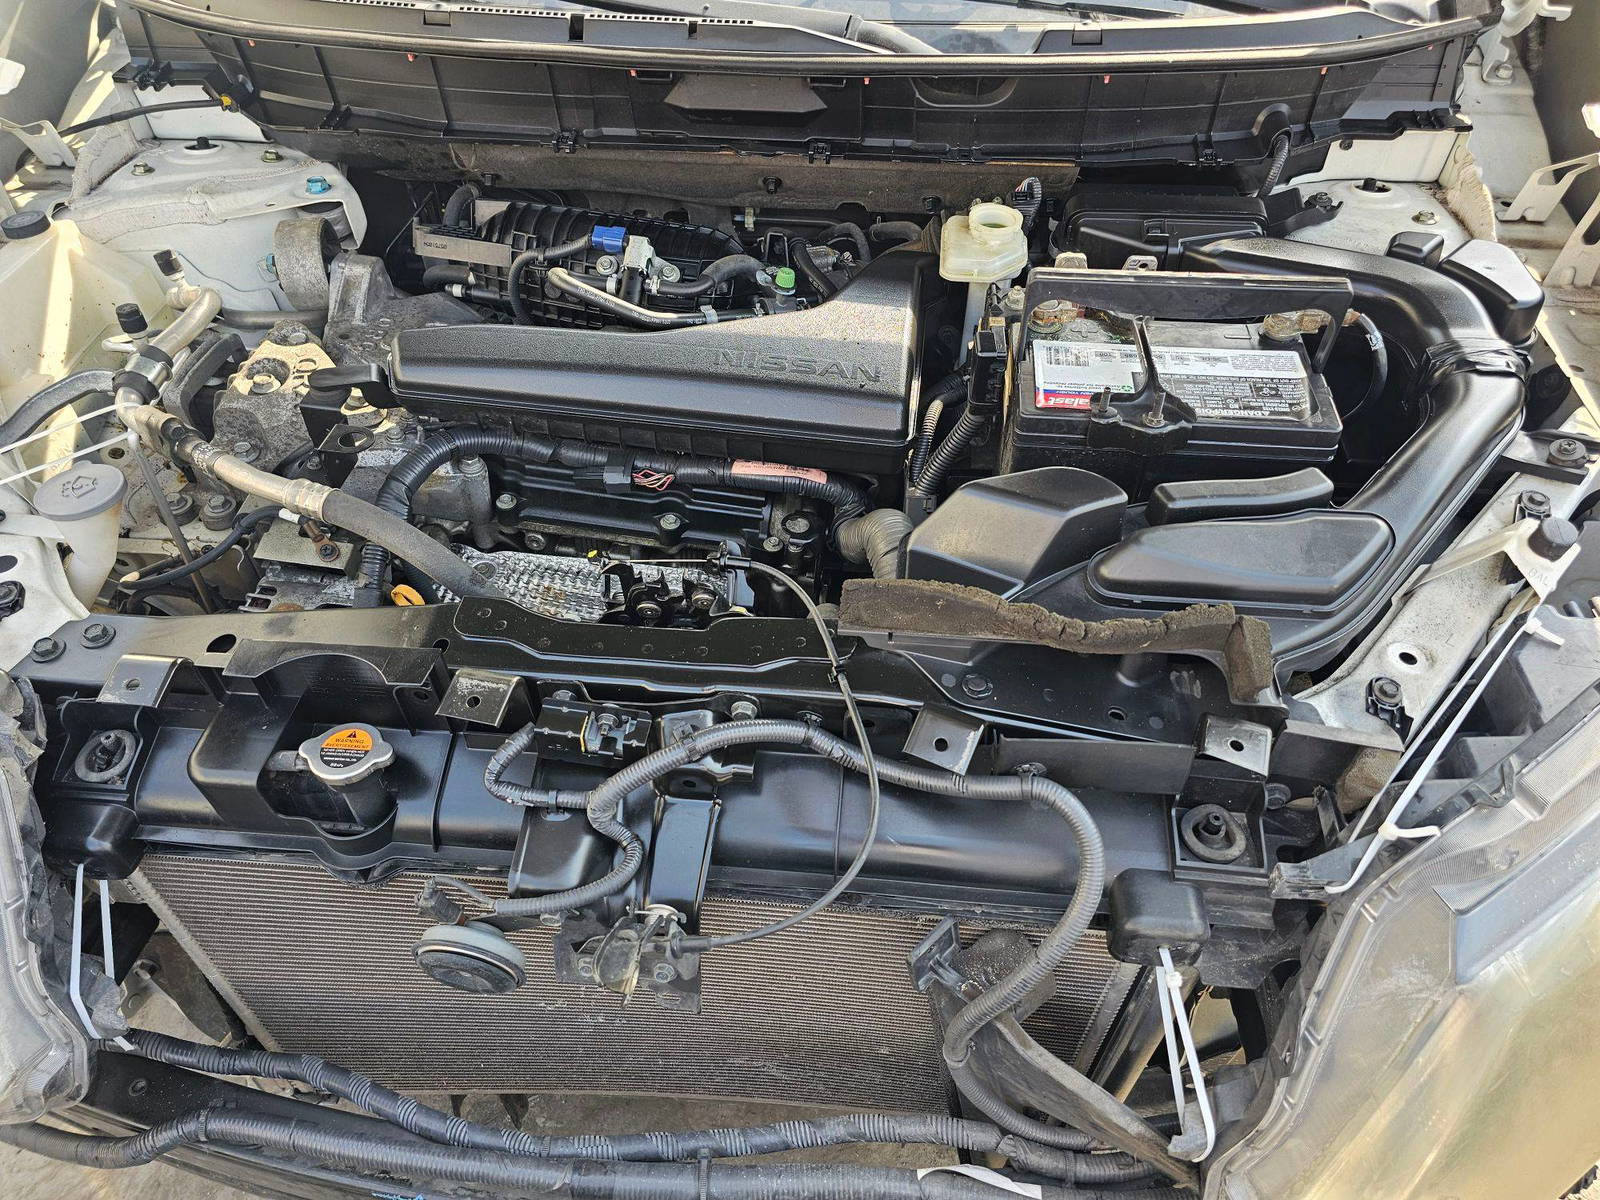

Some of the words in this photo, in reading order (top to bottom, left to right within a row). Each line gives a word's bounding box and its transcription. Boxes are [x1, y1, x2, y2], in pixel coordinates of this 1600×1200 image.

[715, 347, 881, 382] NISSAN
[1047, 396, 1090, 406] alast
[1195, 407, 1262, 416] DANGER/POIS
